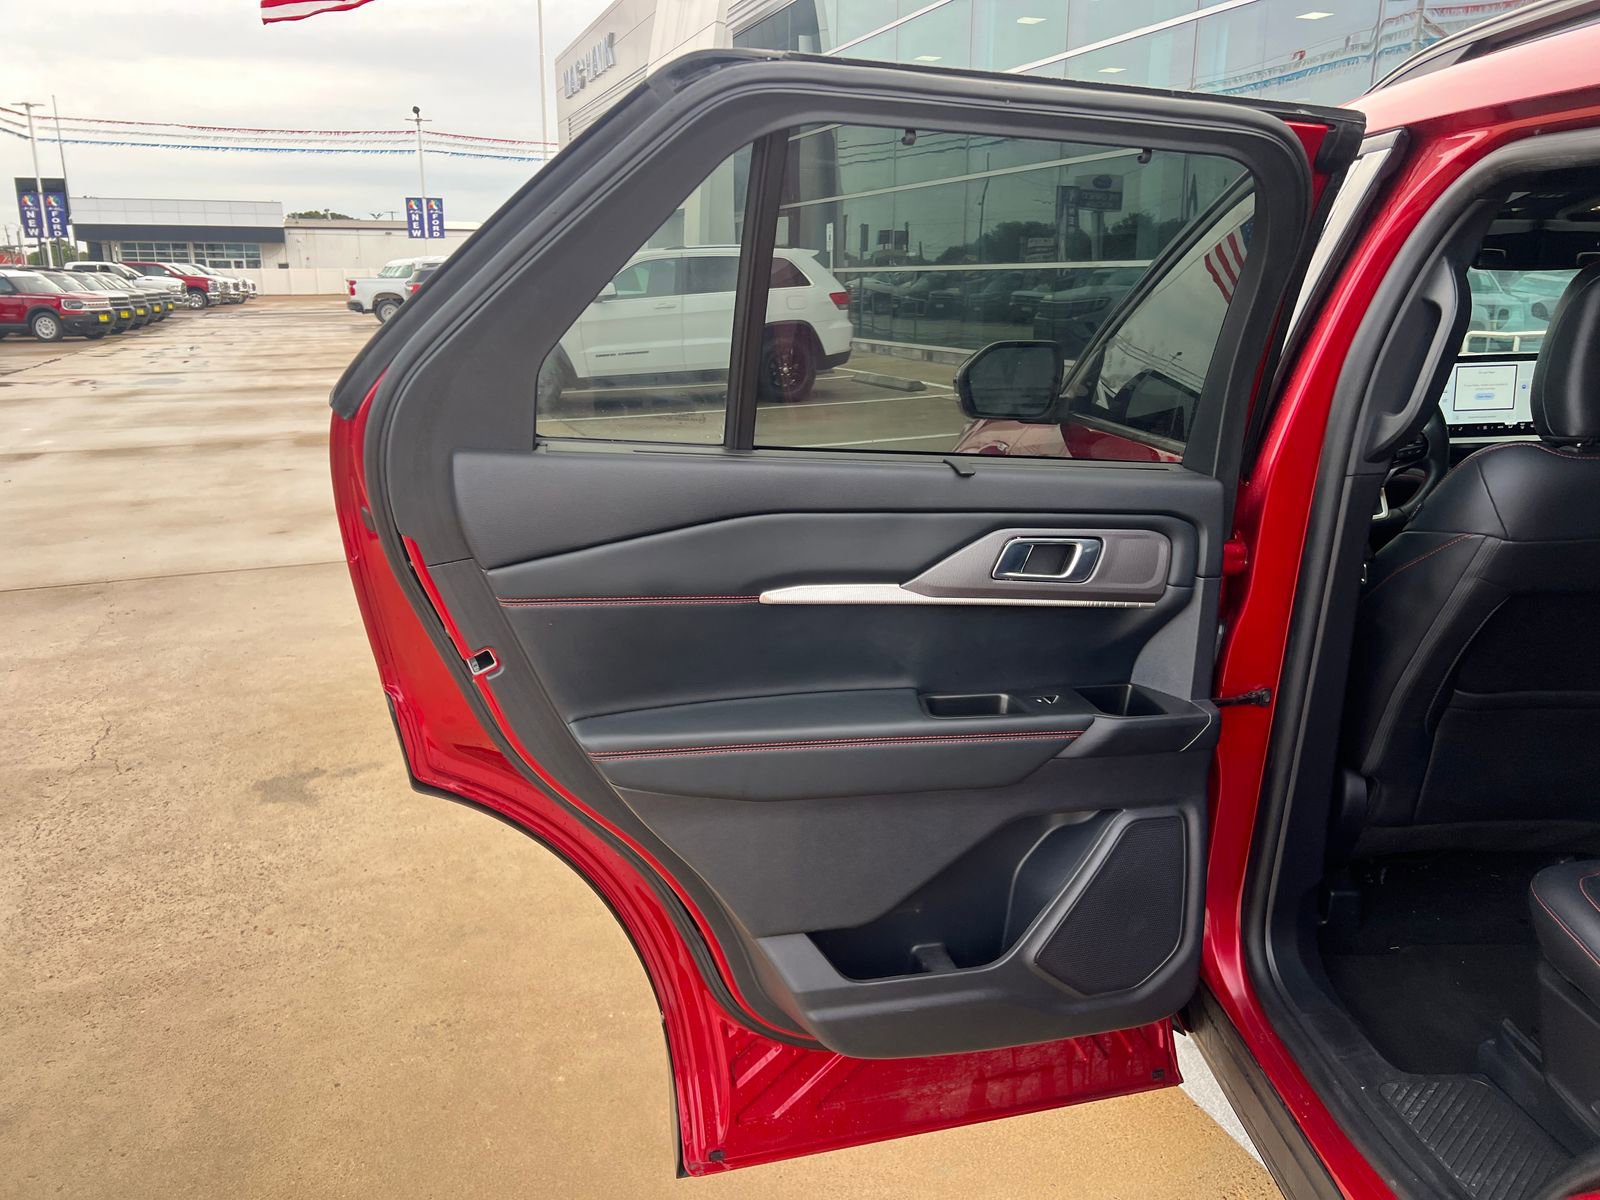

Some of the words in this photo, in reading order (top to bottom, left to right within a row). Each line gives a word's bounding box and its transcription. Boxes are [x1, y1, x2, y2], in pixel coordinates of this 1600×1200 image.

[26, 210, 39, 236] NEW
[51, 211, 62, 236] FORD
[411, 213, 421, 237] NEW
[432, 213, 440, 237] FORD
